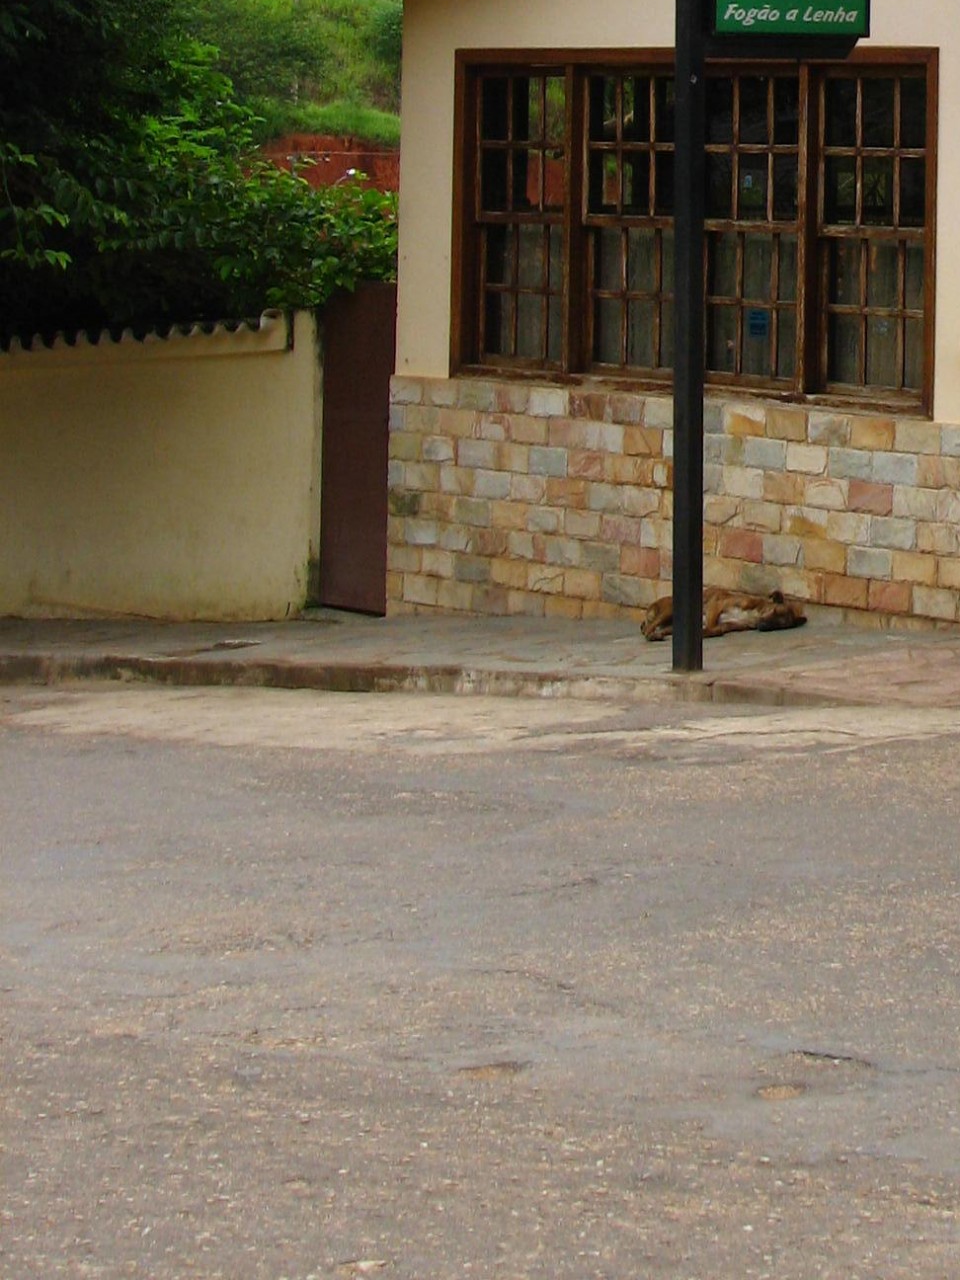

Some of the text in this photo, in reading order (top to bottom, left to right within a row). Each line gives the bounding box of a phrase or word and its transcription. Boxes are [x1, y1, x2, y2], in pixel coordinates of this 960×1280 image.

[723, 4, 858, 26] Fogão a Lenha
